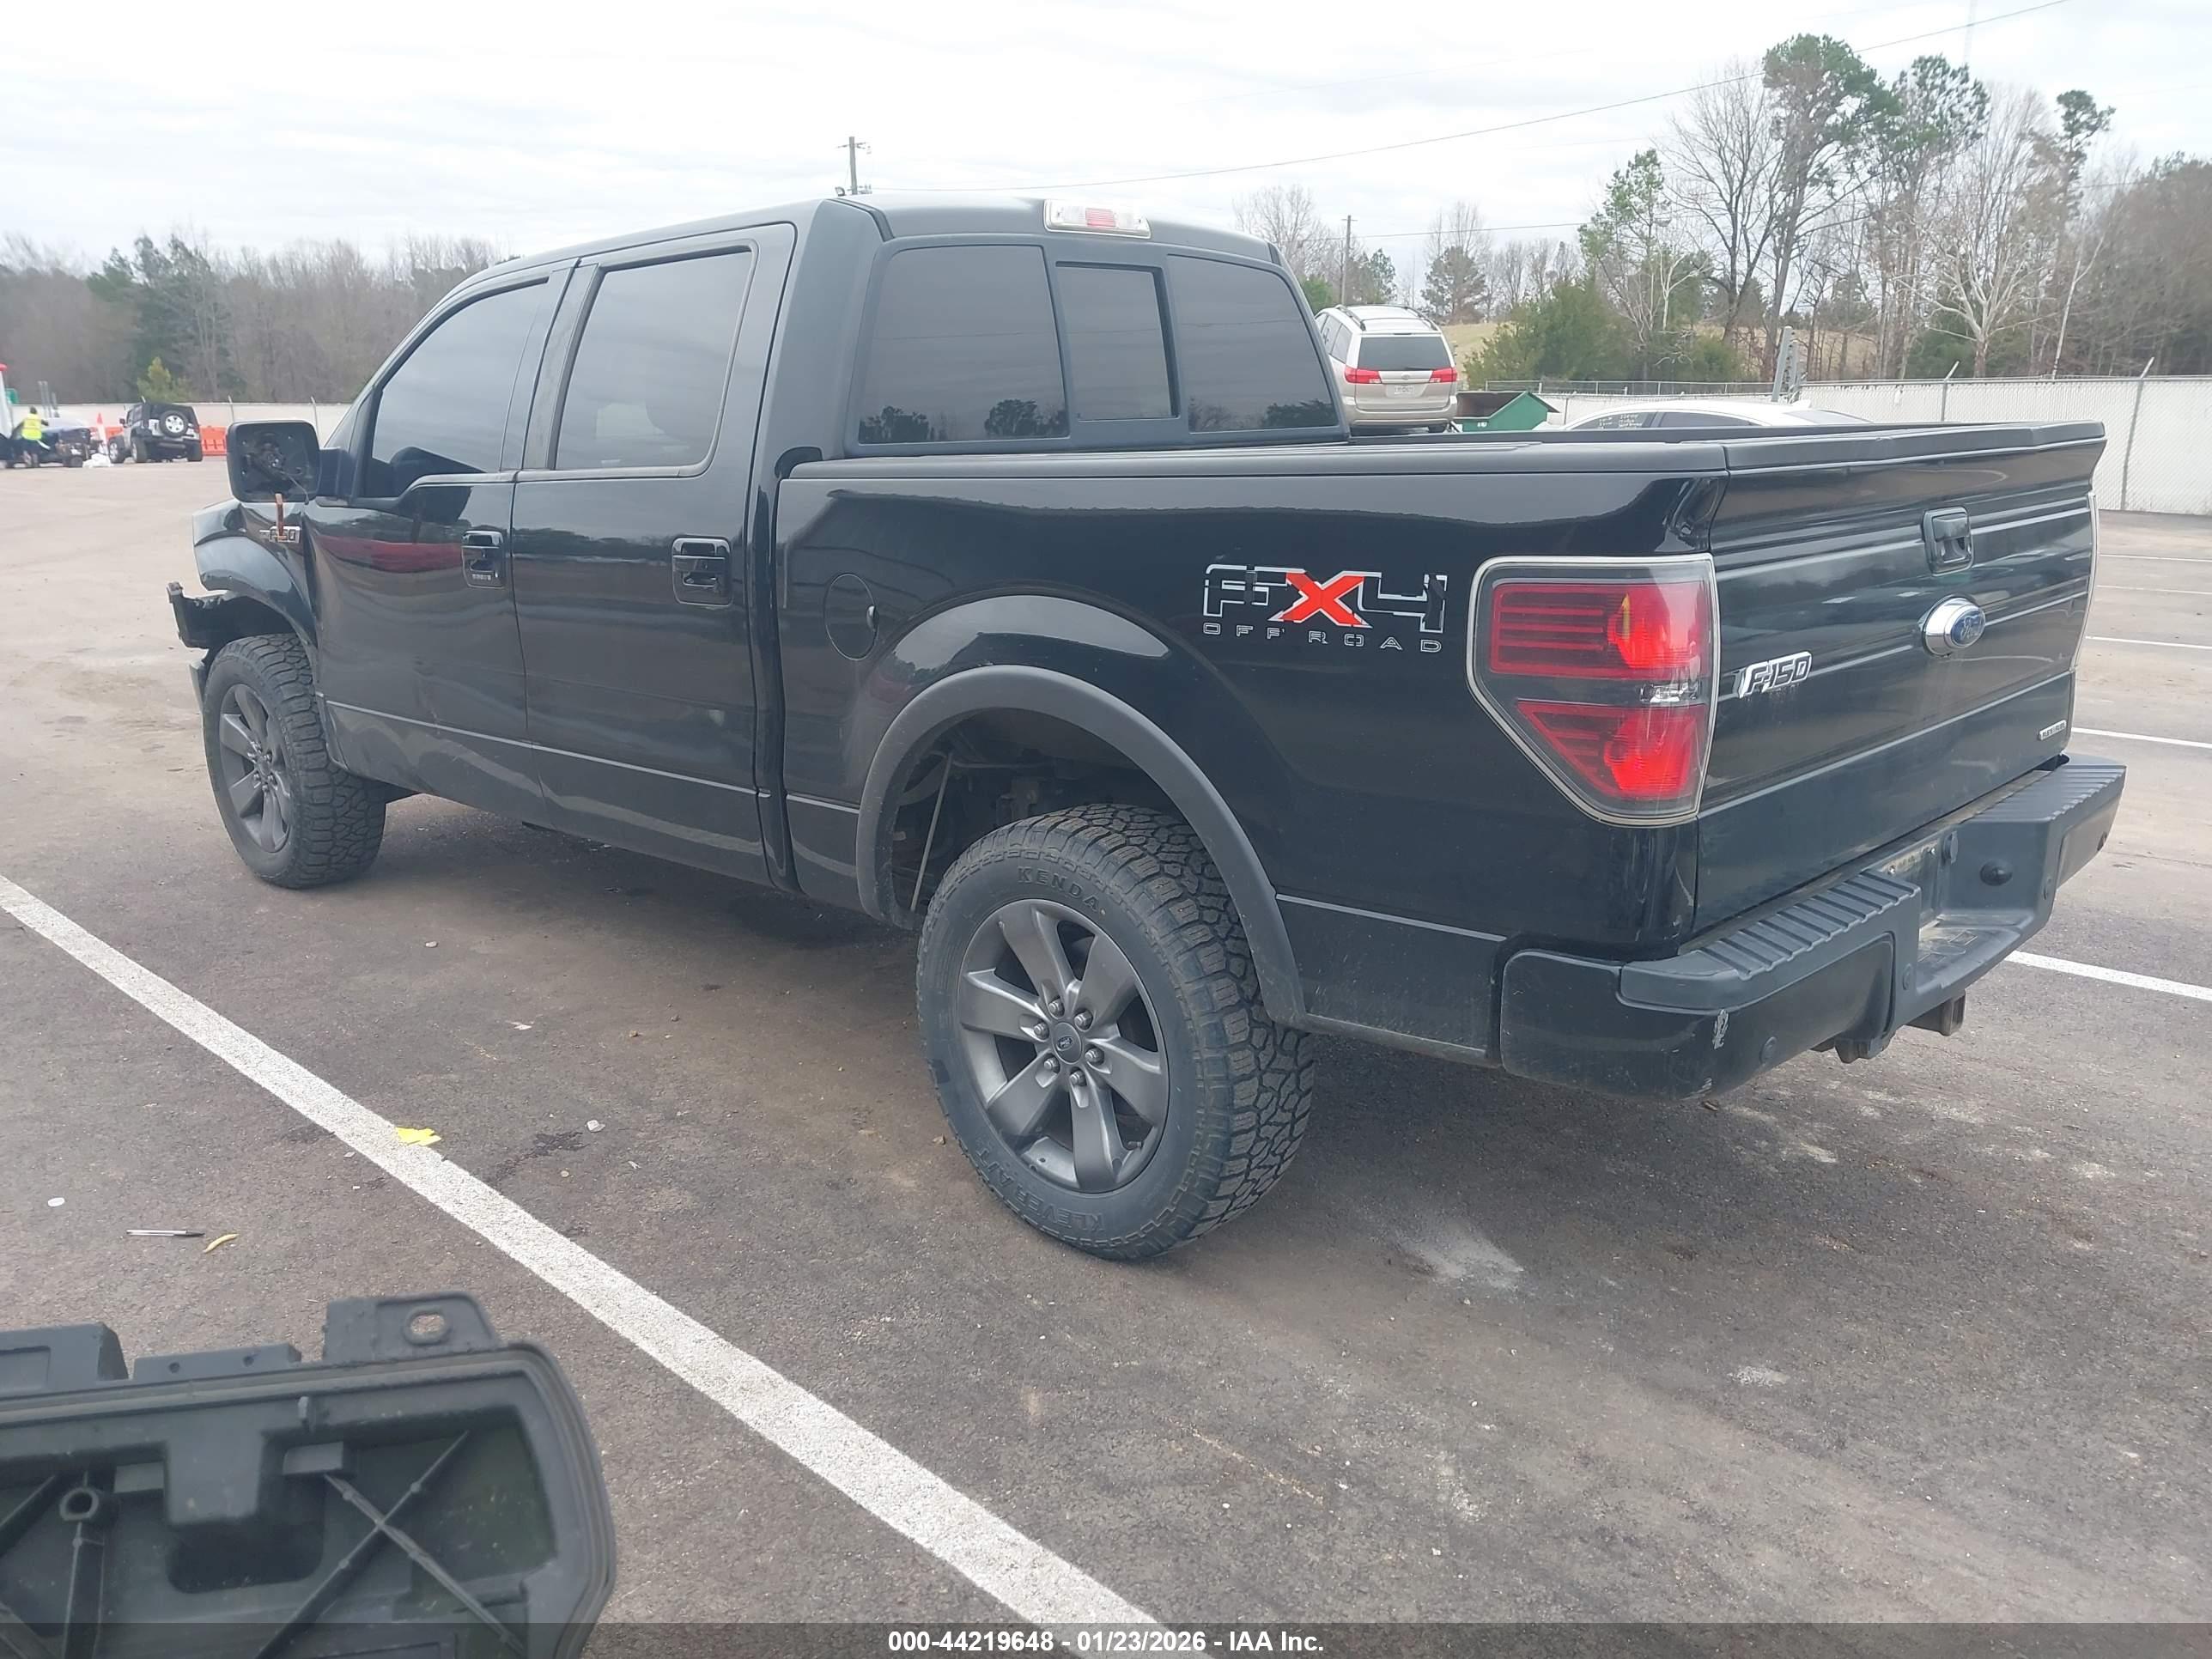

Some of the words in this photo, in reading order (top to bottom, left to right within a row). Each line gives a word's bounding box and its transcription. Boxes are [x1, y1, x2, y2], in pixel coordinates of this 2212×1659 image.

[1203, 563, 1448, 634] FX4
[1203, 623, 1285, 640] OFF
[1308, 630, 1443, 653] ROAD
[1017, 866, 1100, 913] KENDA
